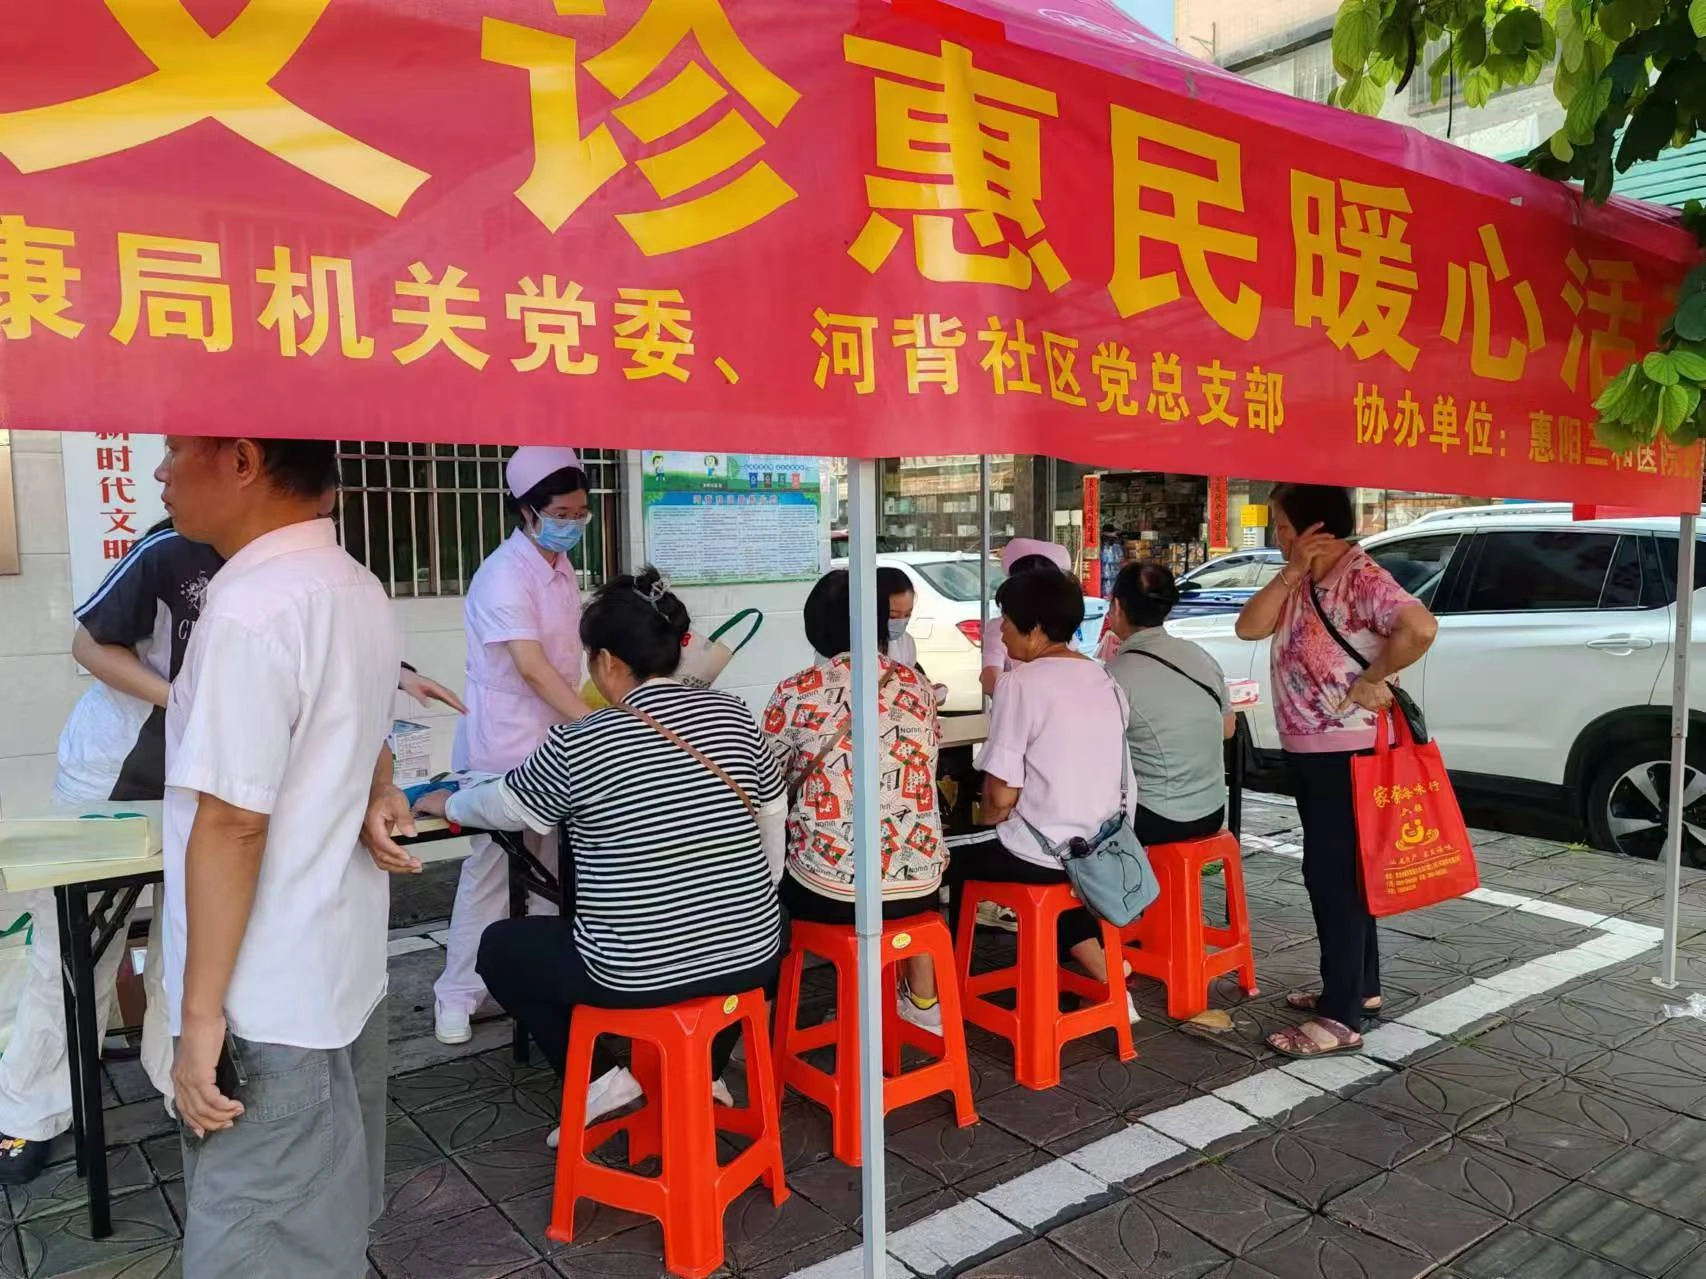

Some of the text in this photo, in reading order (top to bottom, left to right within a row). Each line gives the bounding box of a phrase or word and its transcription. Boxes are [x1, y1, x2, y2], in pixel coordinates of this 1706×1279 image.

[0, 0, 1678, 402] 义诊惠民暖心活
[96, 432, 136, 559] 时代文明
